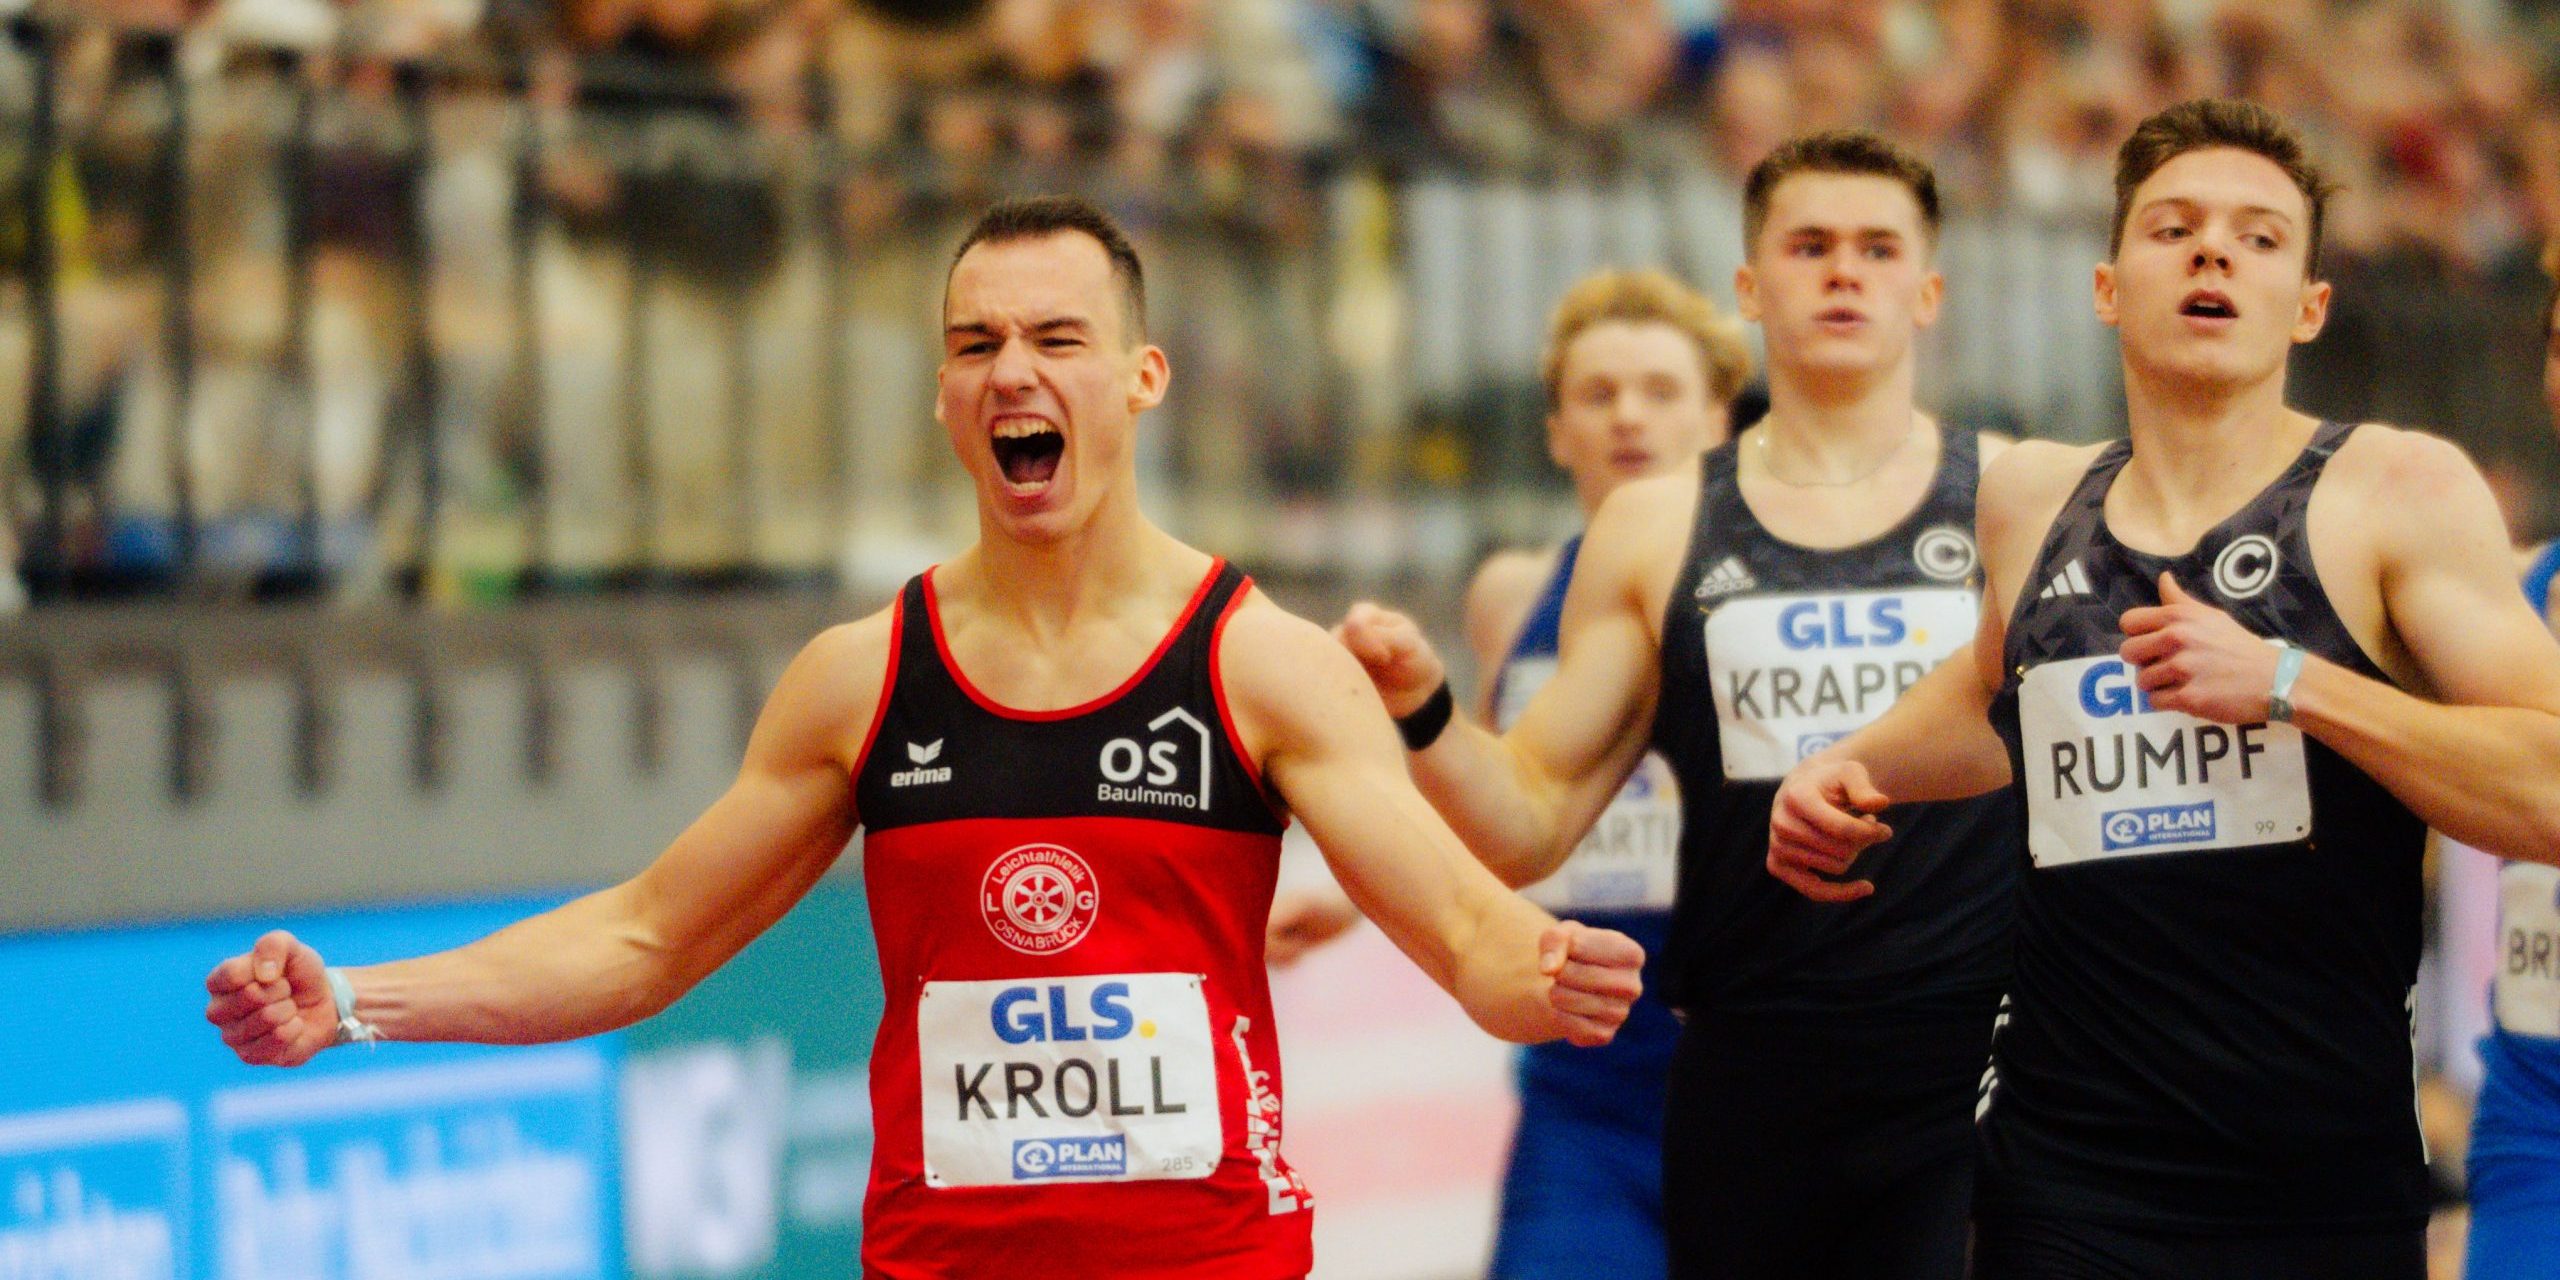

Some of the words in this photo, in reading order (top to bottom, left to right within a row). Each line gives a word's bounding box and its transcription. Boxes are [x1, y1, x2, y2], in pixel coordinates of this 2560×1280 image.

[1729, 659, 1948, 720] KRAPP
[1100, 737, 1179, 786] OS
[2051, 722, 2268, 799] RUMPF
[890, 766, 952, 787] erima
[1097, 783, 1197, 809] BauImmo
[2147, 808, 2212, 832] PLAN
[2254, 820, 2276, 836] 99
[2148, 829, 2211, 842] INTERNATIONAL
[991, 850, 1086, 885] Leichtathletik
[986, 892, 1001, 913] L
[1075, 890, 1095, 912] G
[954, 1055, 1187, 1122] KROLL
[1058, 1142, 1123, 1162] PLAN
[1162, 1156, 1194, 1173] 285
